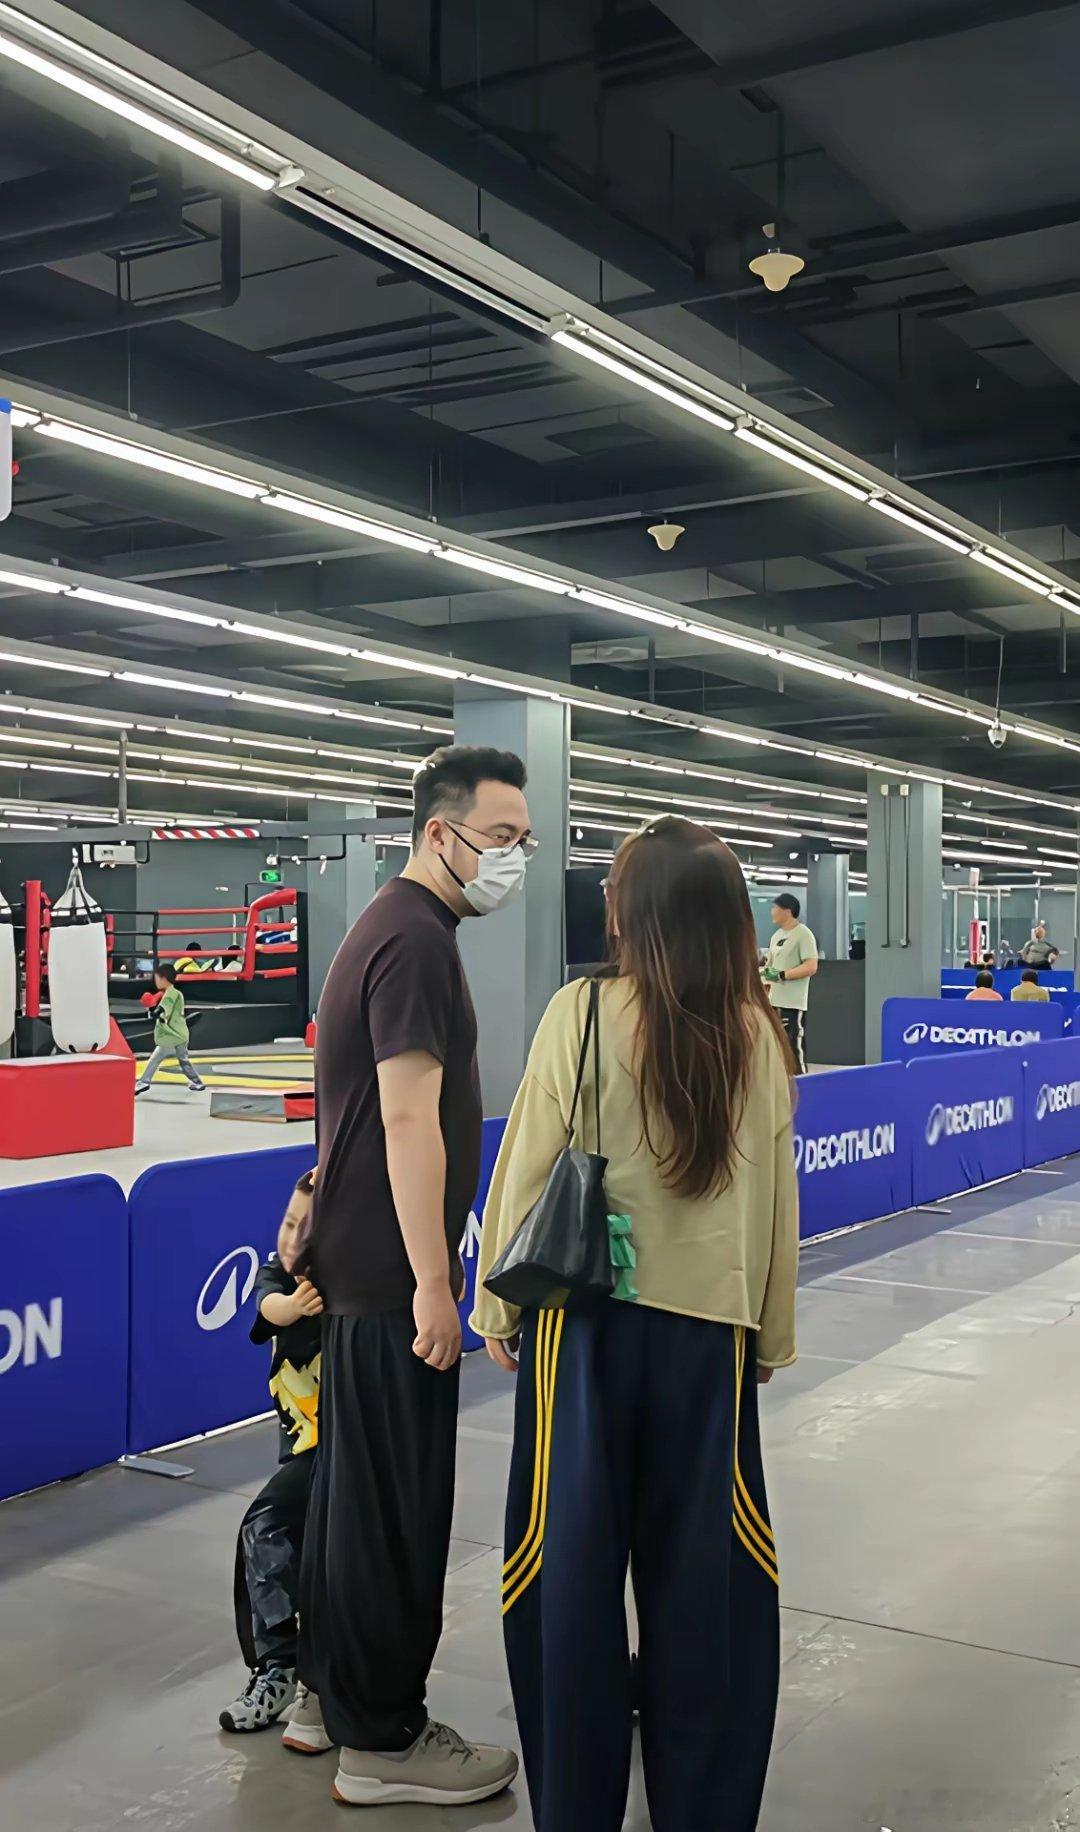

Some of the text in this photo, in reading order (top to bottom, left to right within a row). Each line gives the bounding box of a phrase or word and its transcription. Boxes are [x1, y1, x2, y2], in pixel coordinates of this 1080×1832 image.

[930, 1026, 1041, 1047] DECATHLON
[945, 1096, 1014, 1136] DECATHLON
[804, 1122, 895, 1174] DECATHLON
